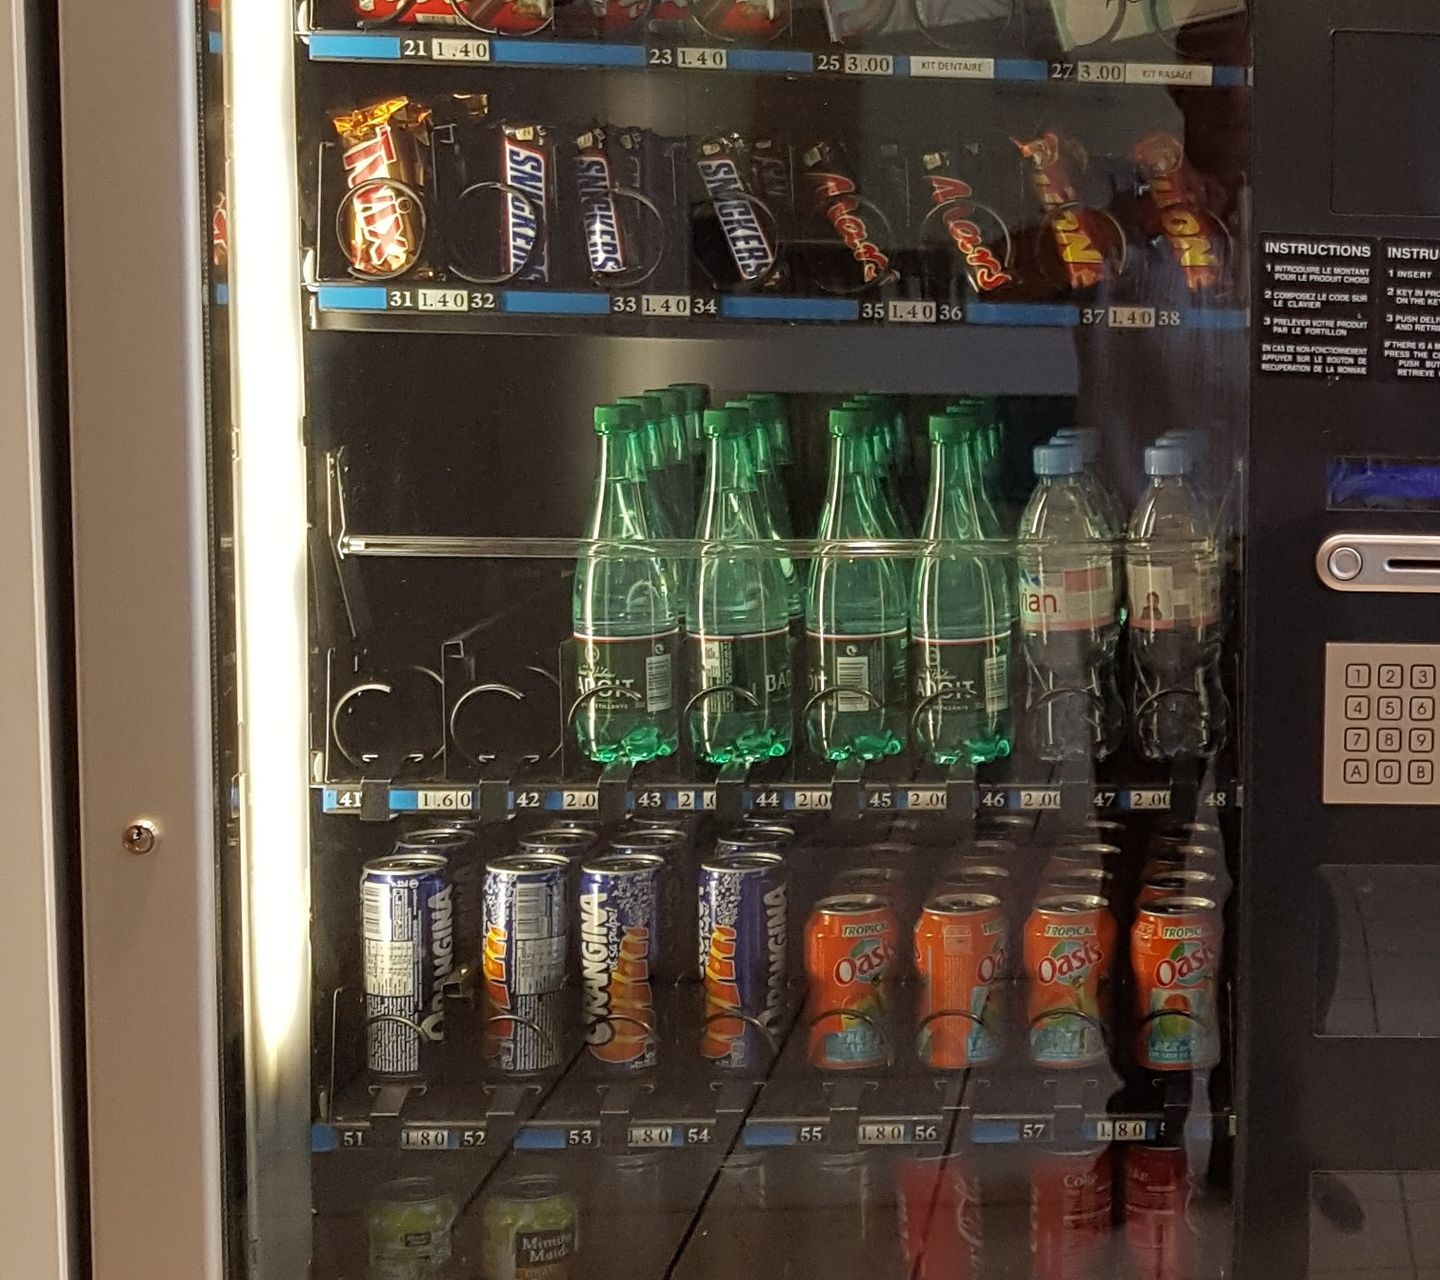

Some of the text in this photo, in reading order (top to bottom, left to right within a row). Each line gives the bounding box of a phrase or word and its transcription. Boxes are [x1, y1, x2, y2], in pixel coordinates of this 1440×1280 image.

[404, 39, 487, 58] 21 1.40
[650, 49, 723, 66] 23 1.40
[817, 55, 890, 72] 25 3.00
[1052, 63, 1073, 79] 27
[344, 124, 408, 266] TWIX
[1264, 242, 1371, 257] INSTRUCTIONS
[1388, 269, 1394, 277] 1
[1397, 271, 1432, 279] INSERT
[1387, 287, 1394, 296] 2
[1396, 288, 1414, 296] KEY
[390, 291, 496, 309] 31 1.40 32
[614, 297, 718, 314] 33 1.40 34
[862, 303, 962, 320] 35 1.40 36
[1082, 309, 1180, 326] 37 1.40 38
[1386, 314, 1393, 322] 3
[1395, 315, 1419, 323] PUSH
[339, 791, 363, 807] 41
[516, 792, 540, 808] 42
[638, 792, 662, 808] 43
[755, 792, 780, 807] 44
[869, 792, 892, 808] 45
[982, 792, 1005, 808] 46
[1093, 792, 1116, 807] 47
[1204, 792, 1226, 807] 48
[579, 893, 613, 1045] ORANGINA
[1038, 941, 1105, 985] Oasis
[344, 1131, 364, 1146] 51
[463, 1130, 486, 1146] 52
[569, 1130, 592, 1145] 53
[688, 1128, 711, 1143] 54
[800, 1126, 822, 1141] 55
[914, 1125, 937, 1140] 56
[1023, 1123, 1045, 1138] 57
